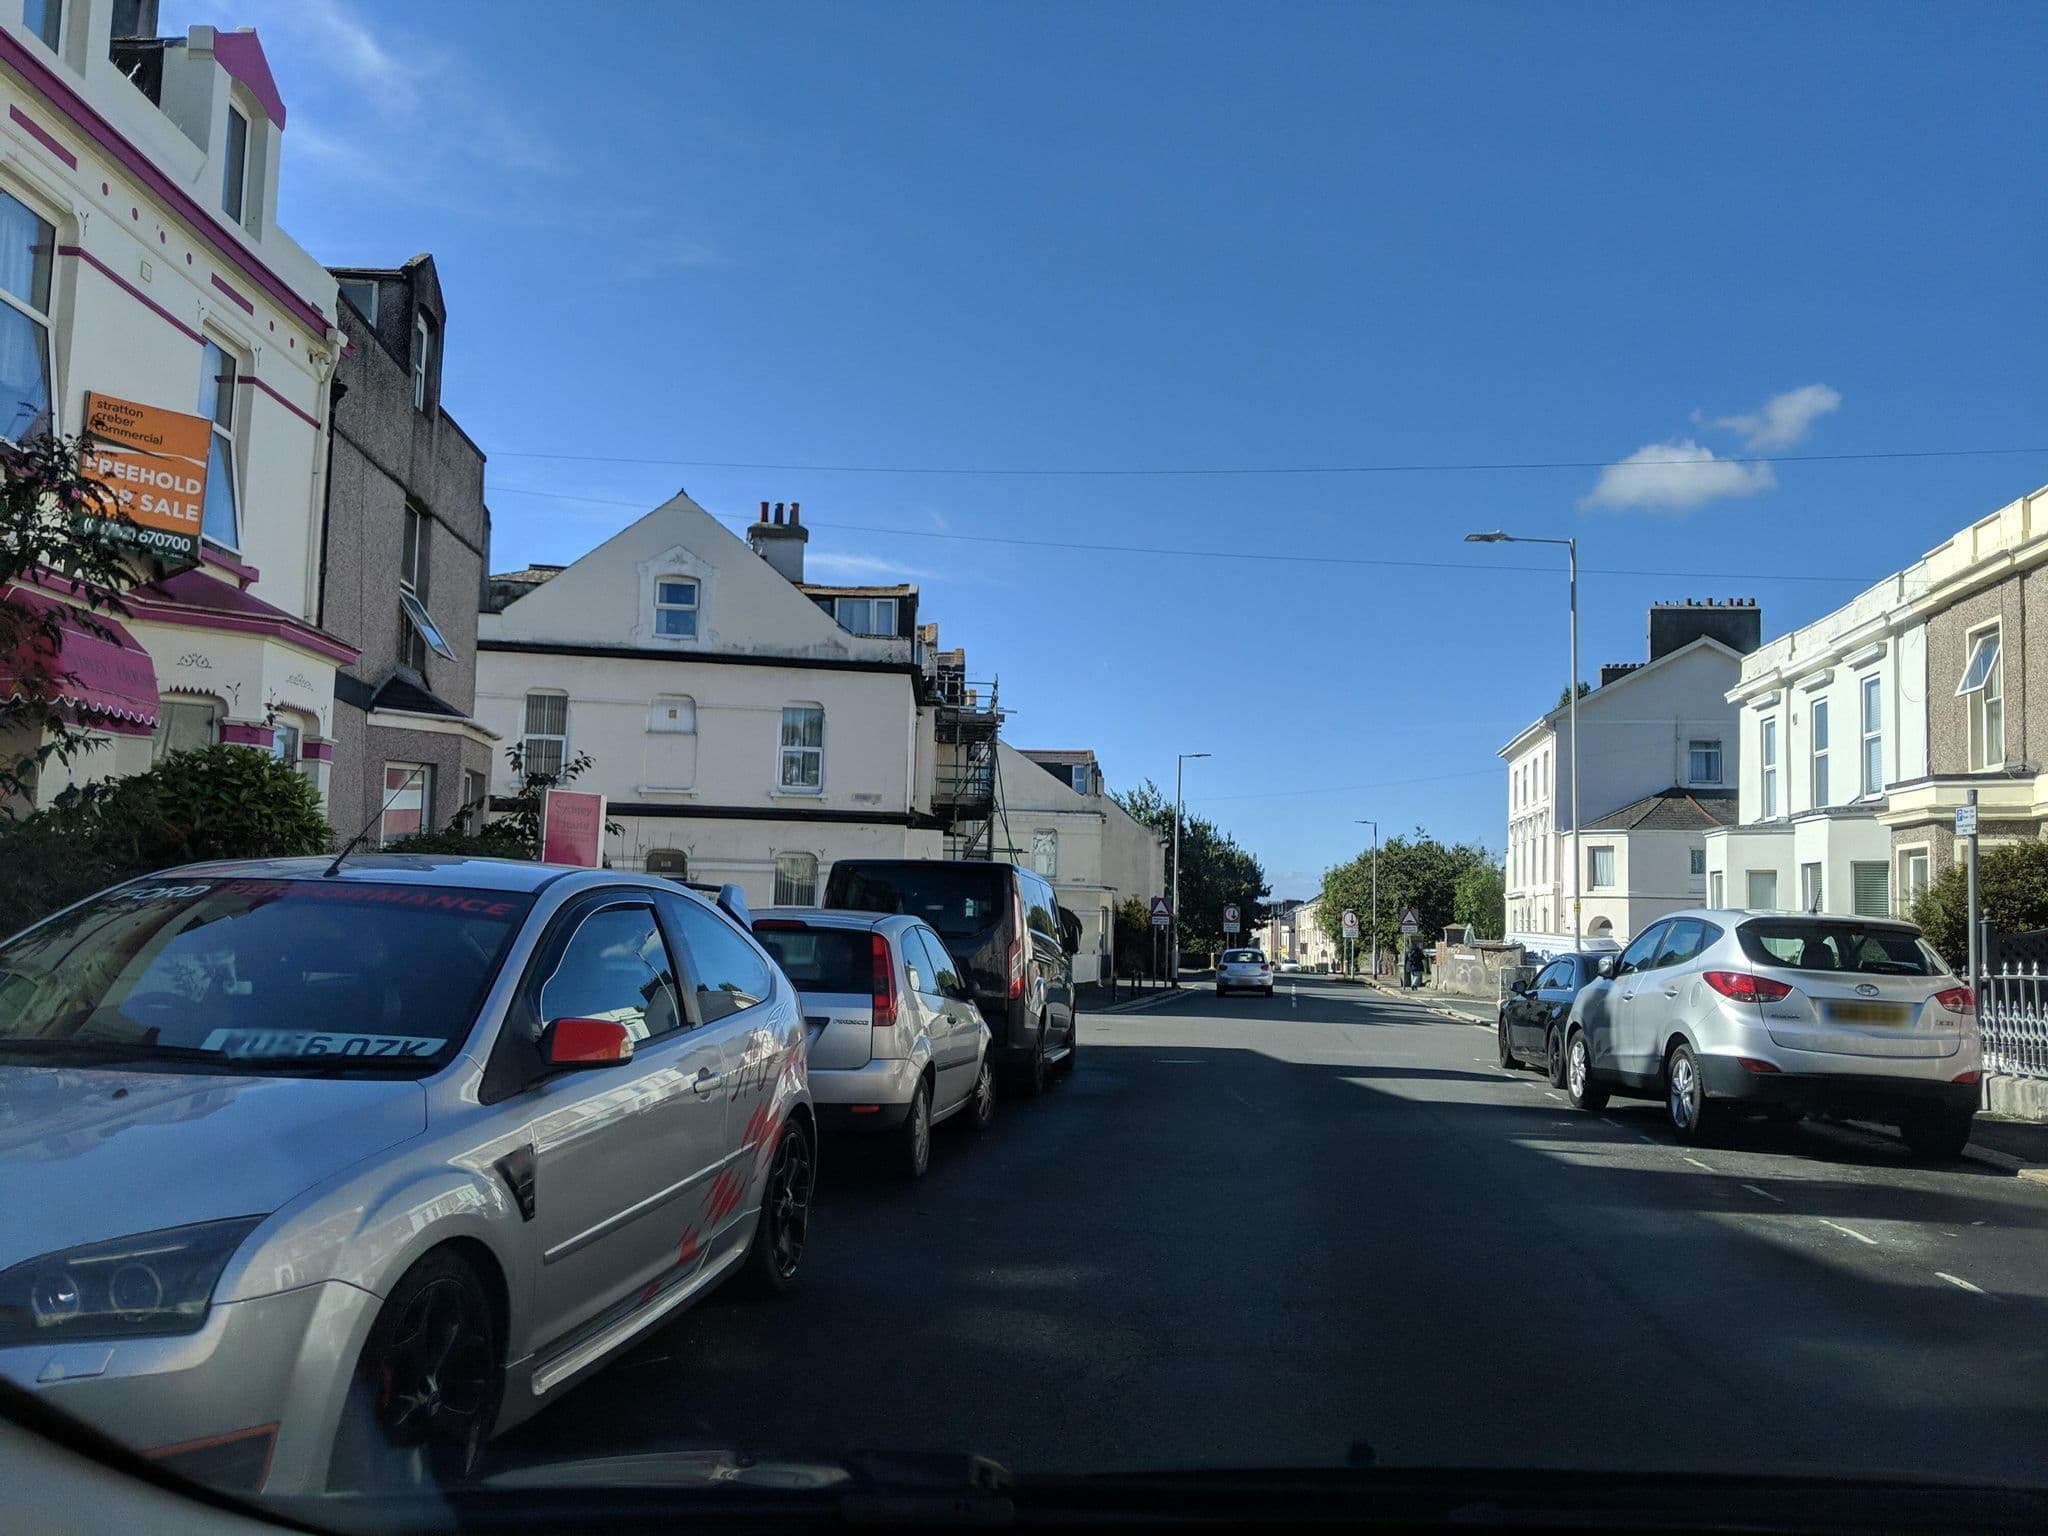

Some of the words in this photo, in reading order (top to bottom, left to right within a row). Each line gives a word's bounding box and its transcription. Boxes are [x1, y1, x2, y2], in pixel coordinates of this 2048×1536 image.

[96, 400, 144, 418] stratton
[96, 412, 135, 428] creber
[95, 422, 163, 445] commercial
[85, 456, 202, 495] FREEHOLD
[140, 494, 199, 522] SALE
[138, 529, 191, 552] 670700
[111, 885, 211, 902] FORD
